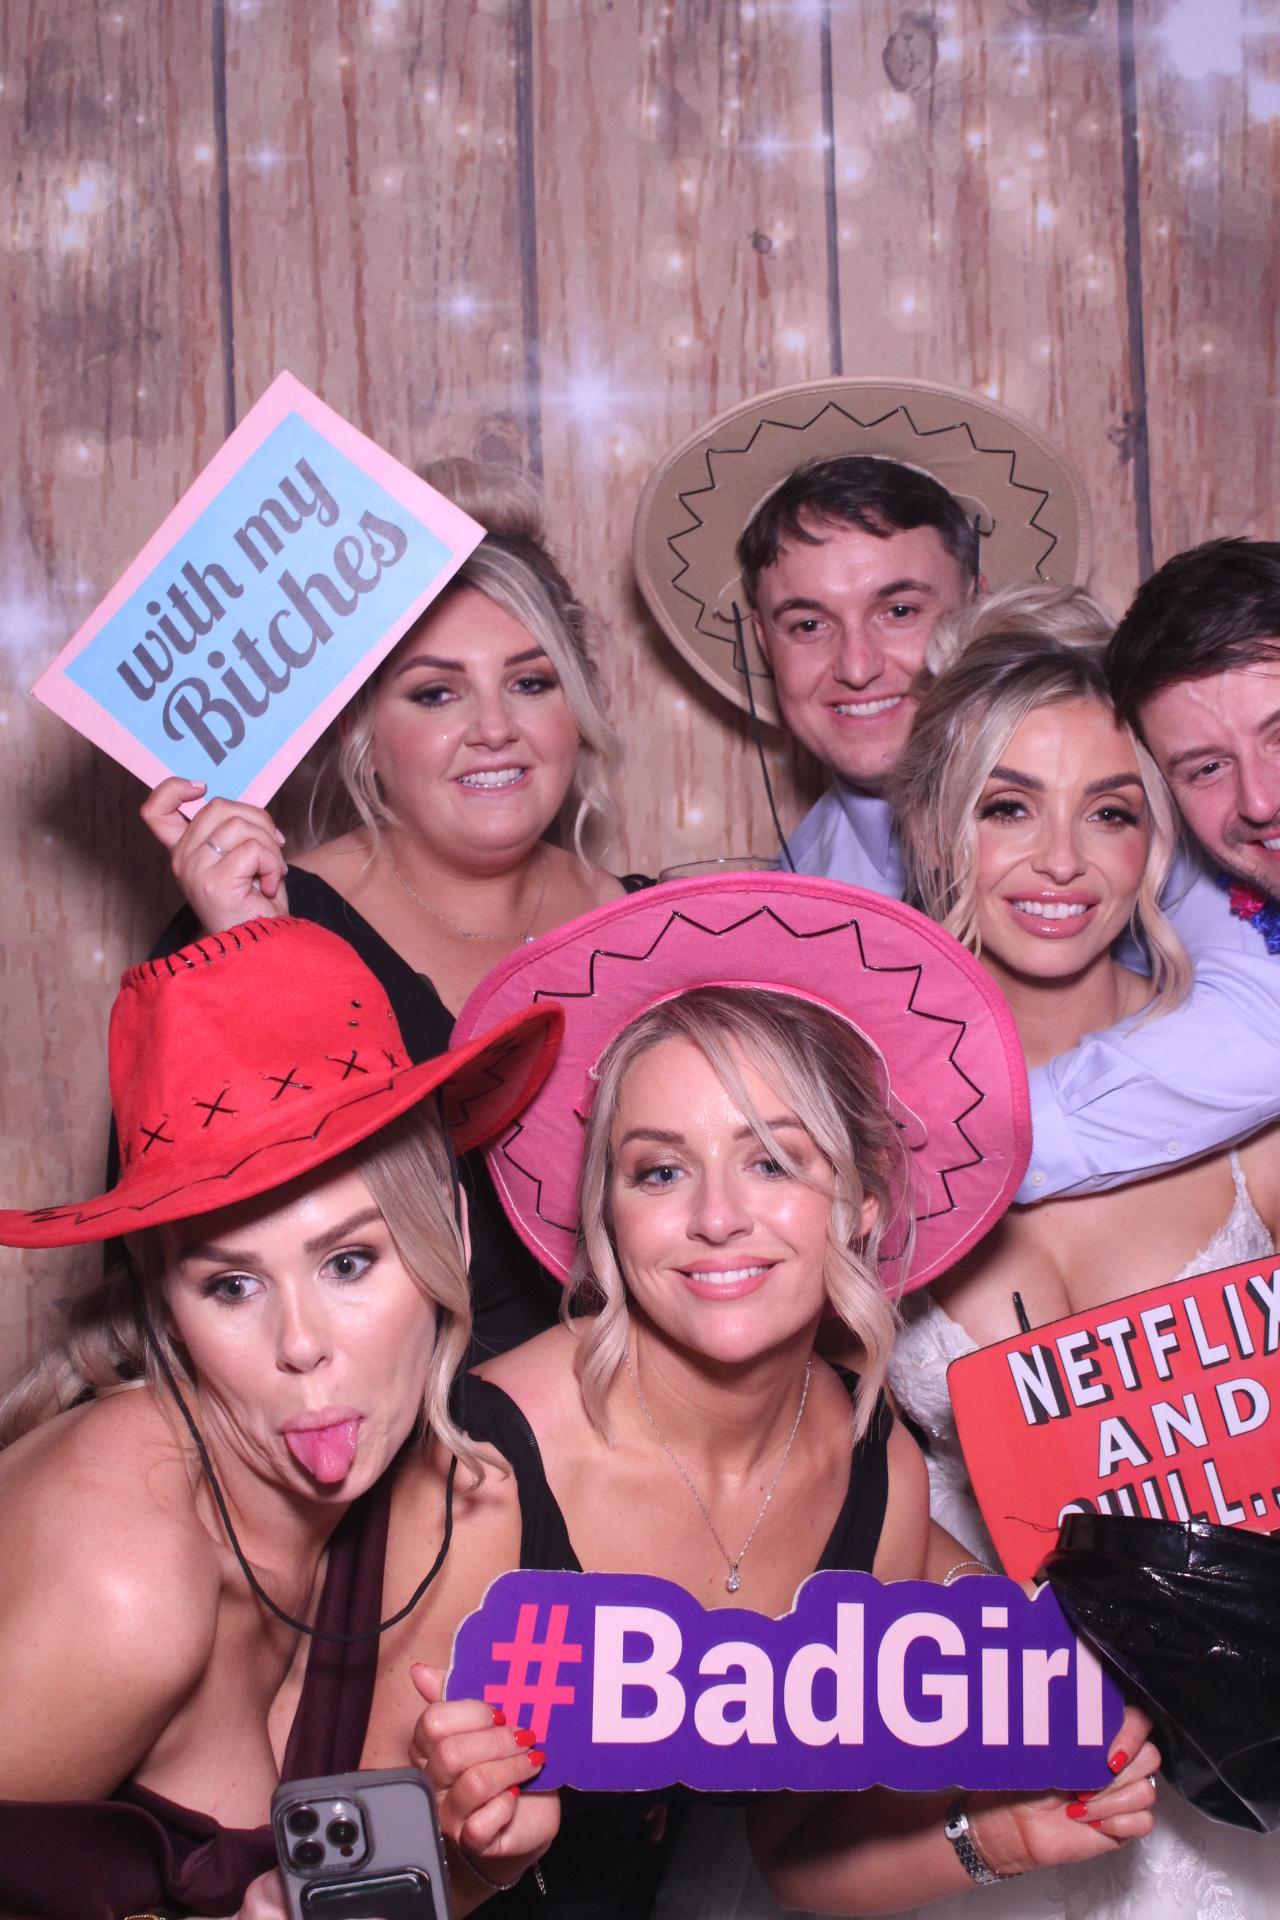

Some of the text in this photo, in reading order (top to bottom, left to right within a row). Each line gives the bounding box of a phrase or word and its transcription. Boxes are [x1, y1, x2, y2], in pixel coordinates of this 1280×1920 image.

[116, 457, 340, 701] with my
[162, 510, 408, 767] Bitches
[1006, 1269, 1280, 1425] NETFLIX
[1098, 1377, 1271, 1479] AND
[483, 1602, 1104, 1747] #BadGirl
